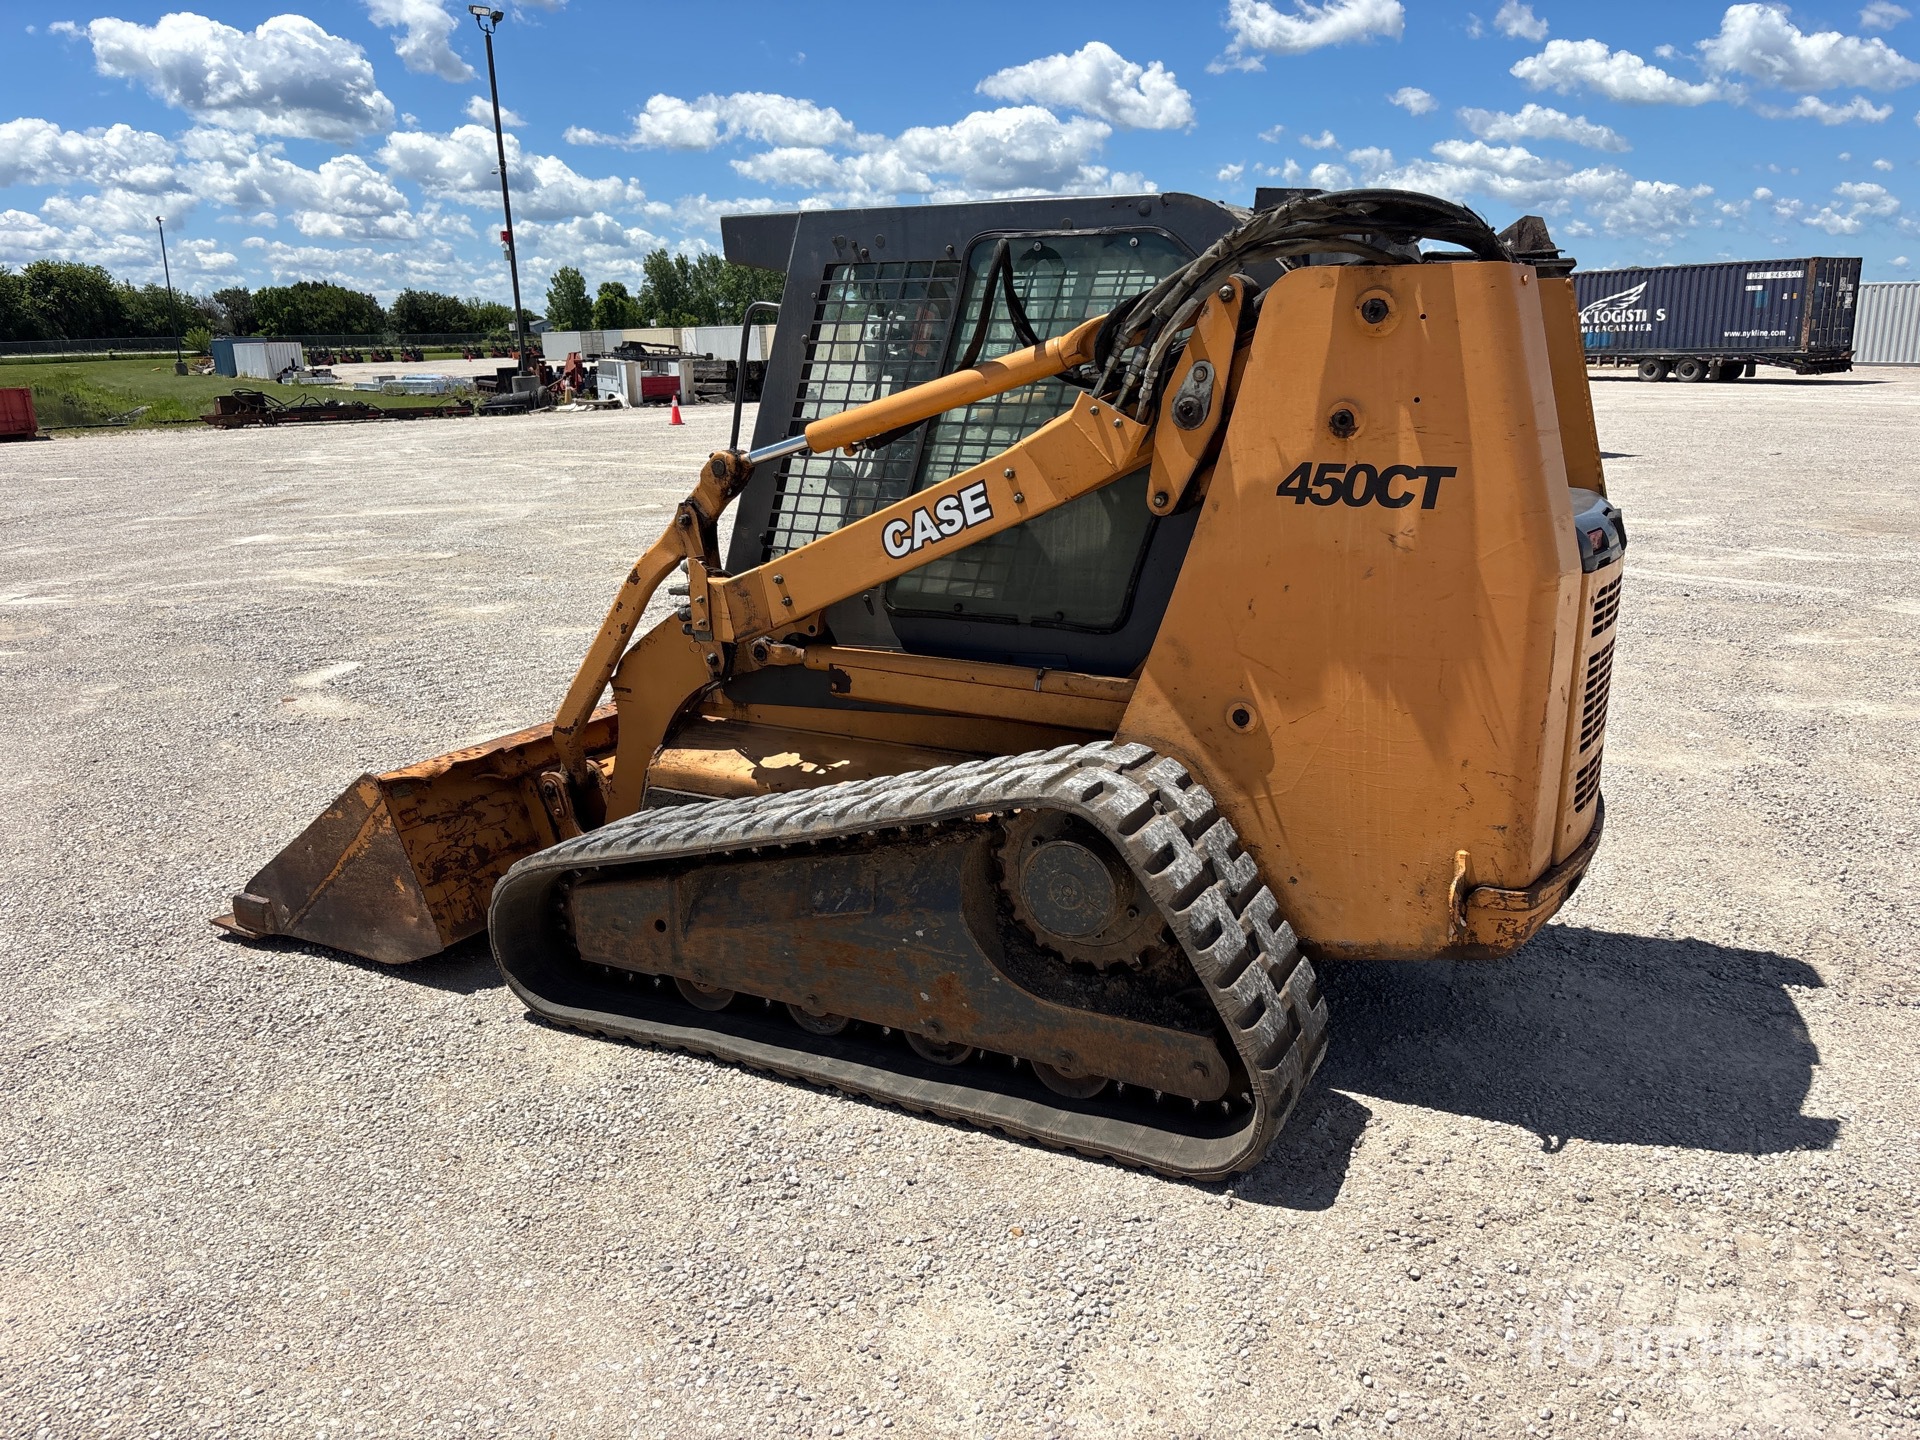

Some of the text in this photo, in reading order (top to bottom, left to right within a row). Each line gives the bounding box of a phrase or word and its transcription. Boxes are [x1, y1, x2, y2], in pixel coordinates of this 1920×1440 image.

[1580, 323, 1652, 334] MEGACARRIER
[1723, 329, 1787, 339] www.nykline.com
[1276, 462, 1458, 510] 450CT
[881, 479, 994, 559] CASE
